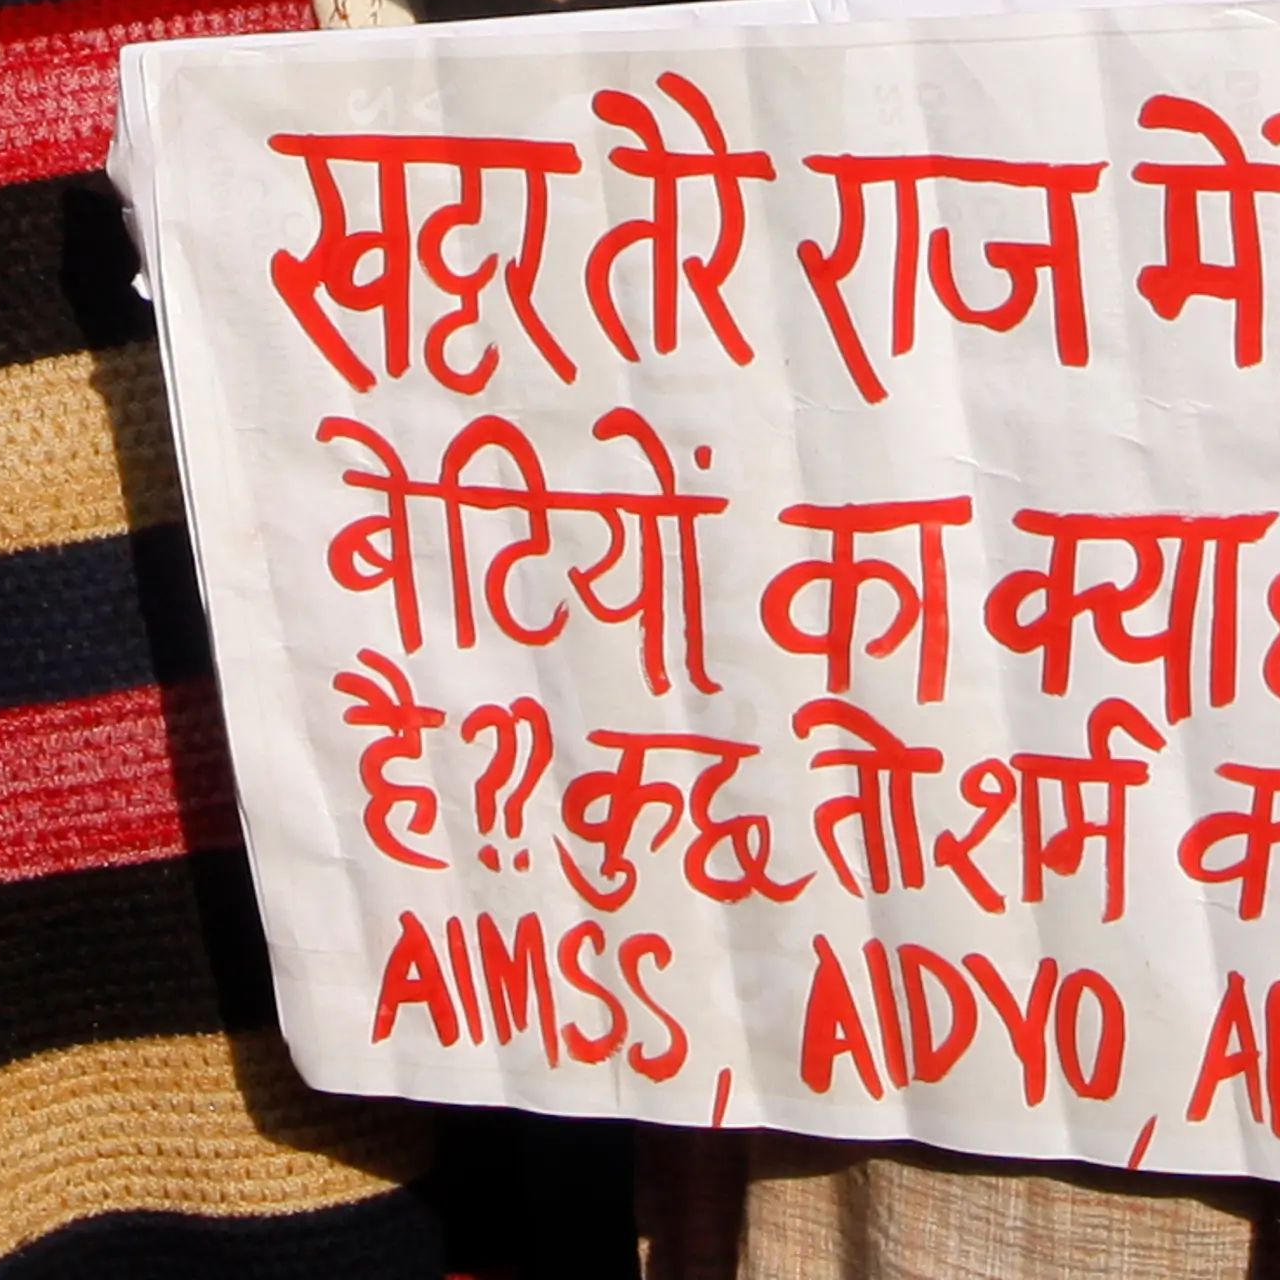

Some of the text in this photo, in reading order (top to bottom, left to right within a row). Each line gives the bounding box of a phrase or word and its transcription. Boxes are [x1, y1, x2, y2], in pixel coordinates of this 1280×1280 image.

[585, 70, 777, 366] तेरे
[798, 153, 1109, 404] राज
[317, 406, 730, 696] बेटियों
[761, 495, 973, 704] का
[985, 508, 1280, 725] क्या
[556, 729, 817, 913] कुछ
[793, 697, 945, 896] तो
[934, 697, 1167, 923] शर्म
